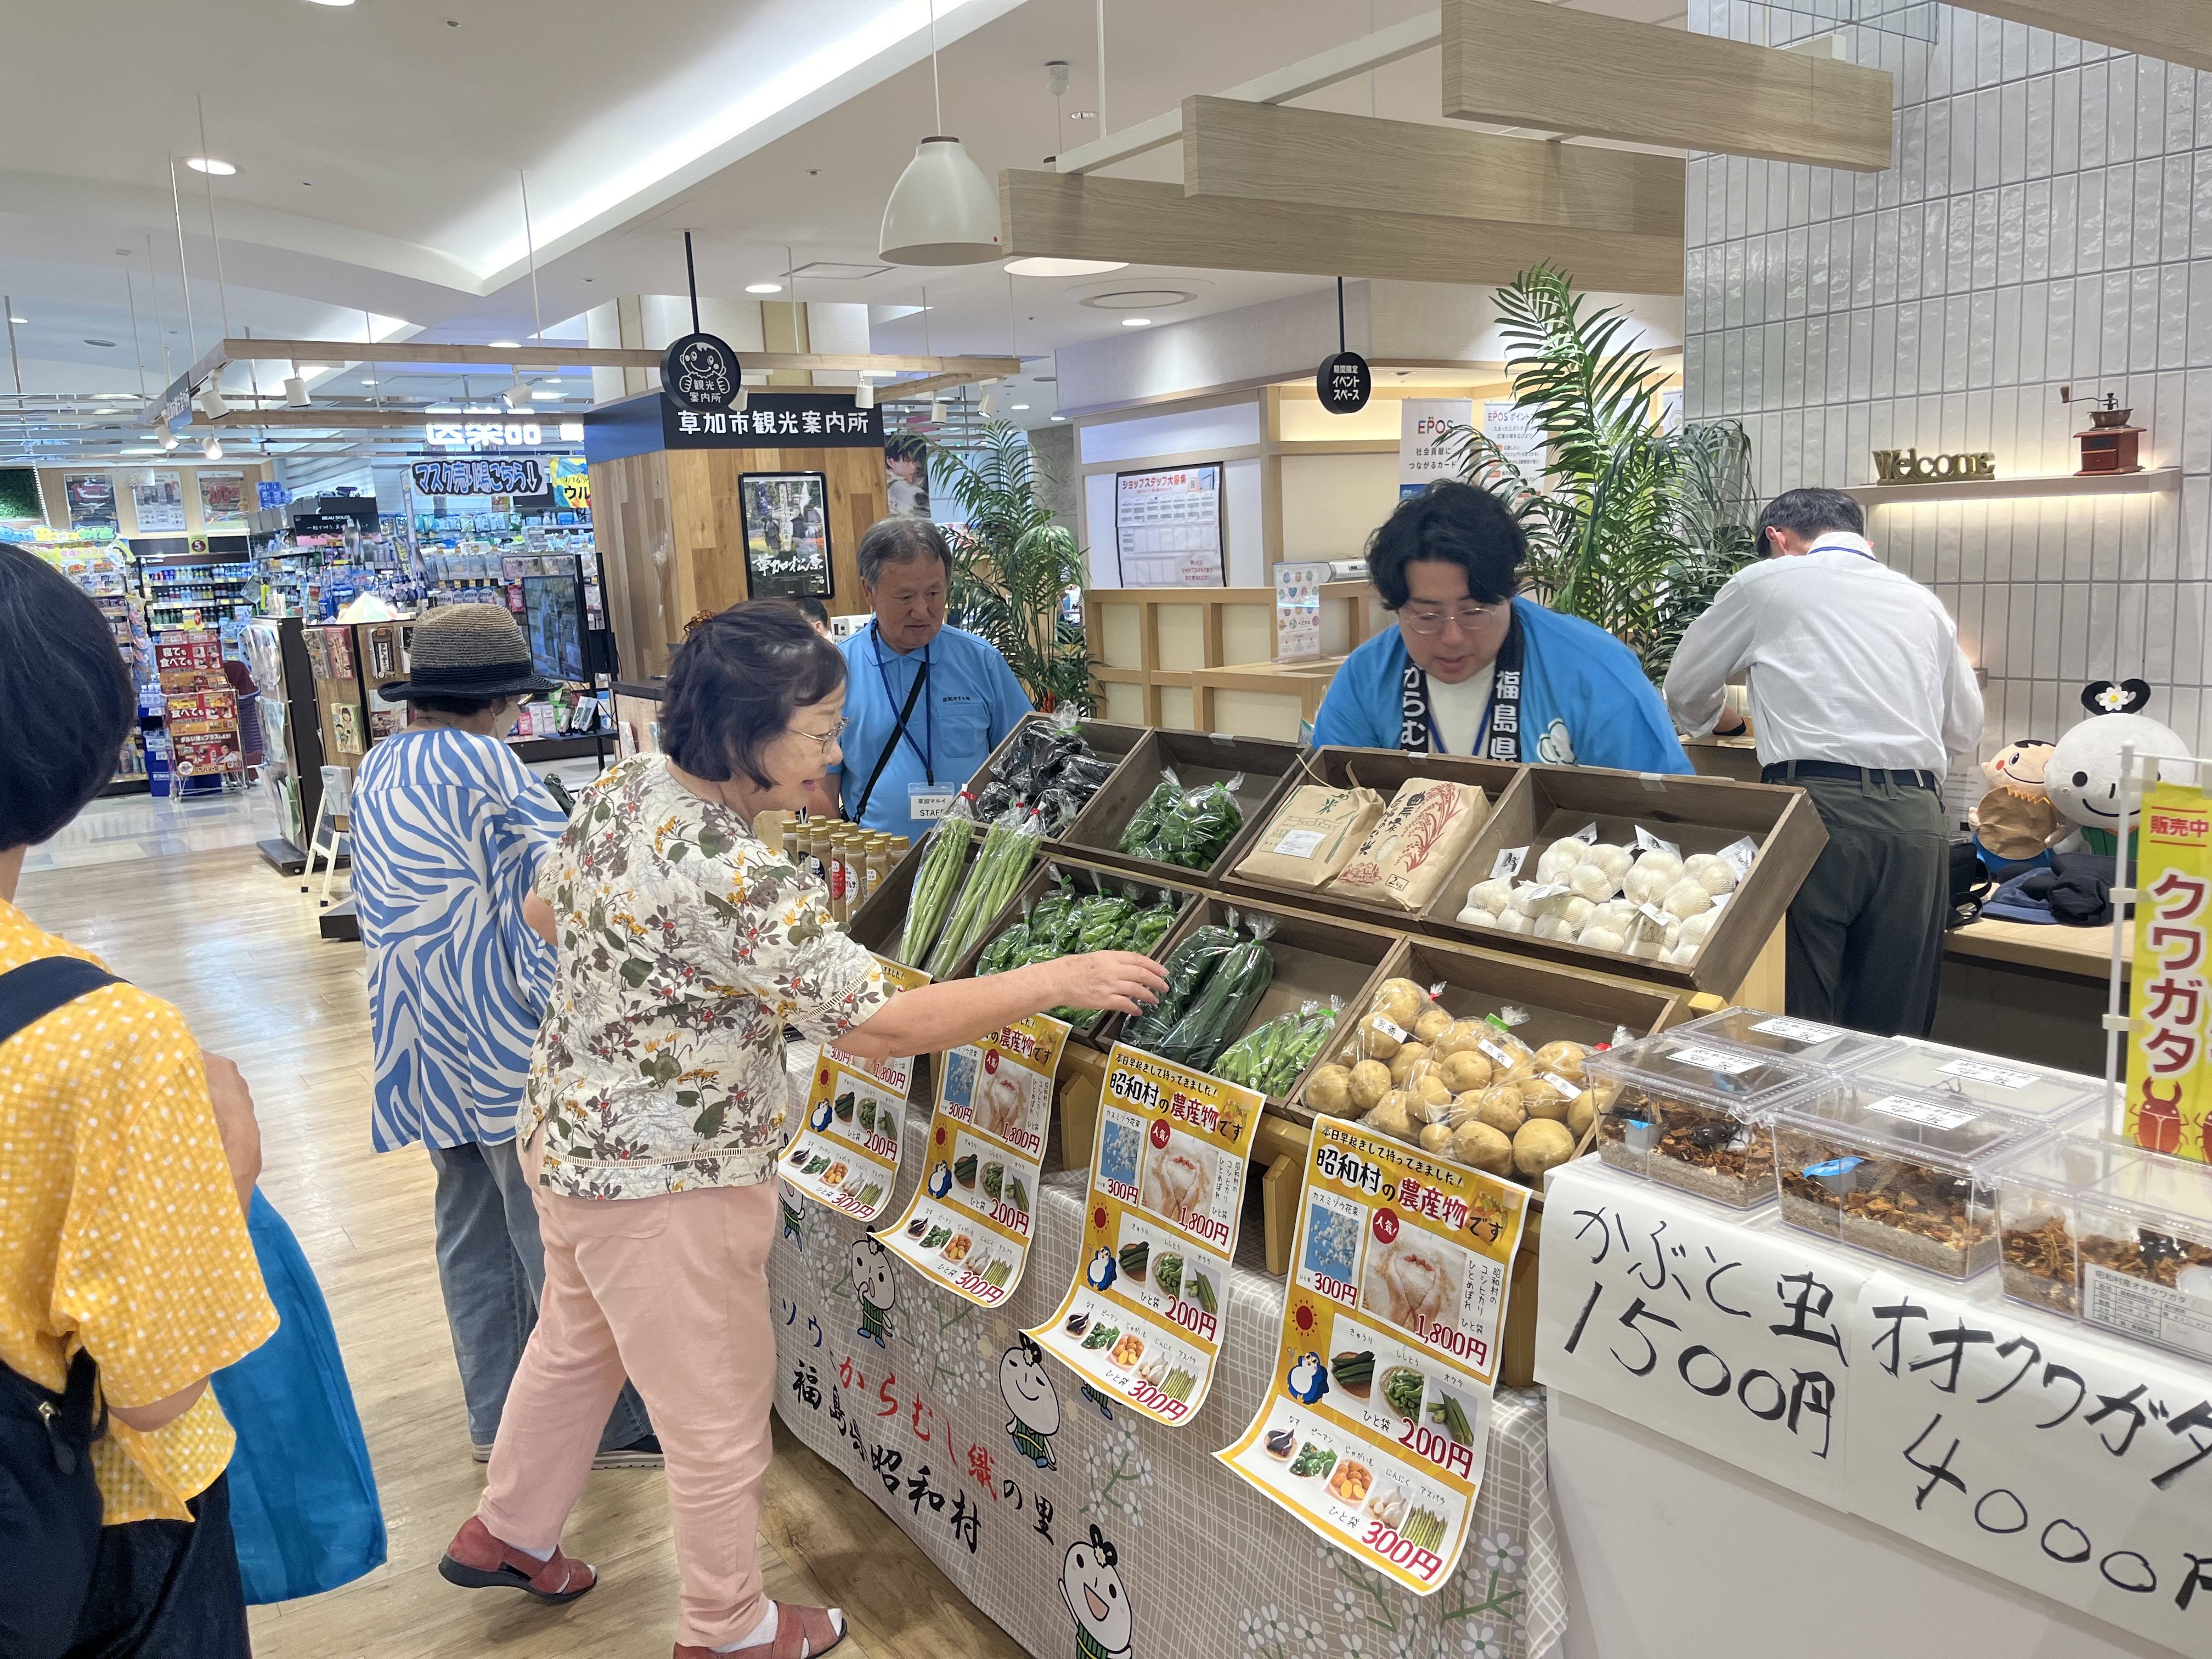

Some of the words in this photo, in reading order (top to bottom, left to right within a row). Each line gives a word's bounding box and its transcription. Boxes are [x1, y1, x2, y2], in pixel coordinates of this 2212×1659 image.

[1334, 365, 1358, 374] 期間限定
[693, 379, 714, 392] 観光
[1333, 376, 1360, 388] イベント
[690, 392, 721, 404] 案内所
[1334, 390, 1359, 401] スペース
[678, 410, 869, 435] 草加市観光案内所
[1488, 411, 1508, 421] EPOS
[1417, 447, 1451, 456] 社会貢献に
[1409, 461, 1457, 470] つながるカード
[1872, 447, 1995, 481] Welcome
[415, 462, 526, 493] マスク売り場こちら
[1122, 474, 1187, 490] ショップスタッフ大募集
[752, 553, 823, 577] 草加松原
[160, 657, 193, 668] 食べても
[1491, 670, 1521, 763] 福島県
[2150, 815, 2209, 839] 販売中
[1388, 876, 1403, 889] 2kg
[2146, 873, 2205, 1074] クワガタ
[1376, 1019, 1397, 1037] 男爵
[986, 1026, 1051, 1064] の農産物です
[1485, 1045, 1506, 1064] 男爵
[831, 1047, 850, 1064] 300円
[986, 1055, 997, 1069] 人気!
[874, 1063, 905, 1090] 1,800円
[1116, 1053, 1217, 1097] 本日早起きして持ってきました!
[949, 1102, 972, 1122] 300円
[1110, 1073, 1243, 1141] 昭和村の農産物です
[1107, 1109, 1140, 1128] カスミソウ花束
[1001, 1122, 1040, 1154] 1,800円
[1153, 1126, 1169, 1143] 人気!
[864, 1130, 898, 1161] 200円
[990, 1150, 1002, 1160] ししとう
[1321, 1125, 1464, 1188] 本日早起きして持ってきました!
[1108, 1178, 1138, 1205] 300円
[1317, 1146, 1503, 1242] 昭和村の農産物です
[832, 1193, 876, 1218] 300円
[970, 1197, 985, 1211] ひと袋
[1212, 1207, 1227, 1220] ひと袋
[1313, 1192, 1358, 1217] カスミソウ花束
[989, 1199, 1029, 1235] 200円
[1179, 1207, 1229, 1246] 1,800円
[1375, 1214, 1397, 1238] 人気!
[1132, 1223, 1149, 1235] きゅうり
[980, 1235, 994, 1247] にんにく
[1165, 1238, 1180, 1251] ししとう
[1198, 1254, 1210, 1265] オクラ
[938, 1263, 957, 1277] ひと袋
[956, 1271, 1004, 1304] 300円
[1314, 1272, 1358, 1306] 300円
[1464, 1260, 1473, 1310] ひとめぼれ
[1479, 1265, 1488, 1317] コシヒカリ
[1490, 1268, 1500, 1305] 昭和村の
[1573, 1207, 1849, 1367] かぶと虫
[2096, 1270, 2186, 1304] 昭和村産オオクワガタ
[1086, 1301, 1094, 1310] なす
[1141, 1292, 1160, 1309] ひと袋
[1102, 1310, 1119, 1323] ピーマン
[1165, 1295, 1217, 1342] 200円
[1126, 1323, 1146, 1339] じゃがいも
[1350, 1328, 1372, 1344] きゅうり
[1461, 1318, 1483, 1335] ひと袋
[1155, 1338, 1172, 1352] にんにく
[1415, 1315, 1488, 1367] 1,800円
[1179, 1350, 1196, 1364] アスパラ
[1397, 1350, 1419, 1367] ししとう
[1106, 1370, 1130, 1386] ひと袋
[1564, 1280, 1835, 1459] 1500円
[1444, 1373, 1463, 1387] オクラ
[1128, 1380, 1188, 1421] 300円
[1290, 1415, 1300, 1426] なす
[1363, 1410, 1390, 1433] ひと袋
[1311, 1427, 1334, 1443] ピーマン
[794, 1359, 982, 1554] 福島県昭和村
[839, 1356, 1054, 1545] からむし織の里
[1345, 1446, 1373, 1467] じゃがいも
[1398, 1418, 1474, 1480] 200円
[1386, 1468, 1410, 1487] にんにく
[1421, 1486, 1446, 1505] アスパラ
[1329, 1506, 1361, 1529] ひと袋
[1362, 1521, 1442, 1581] 300円
